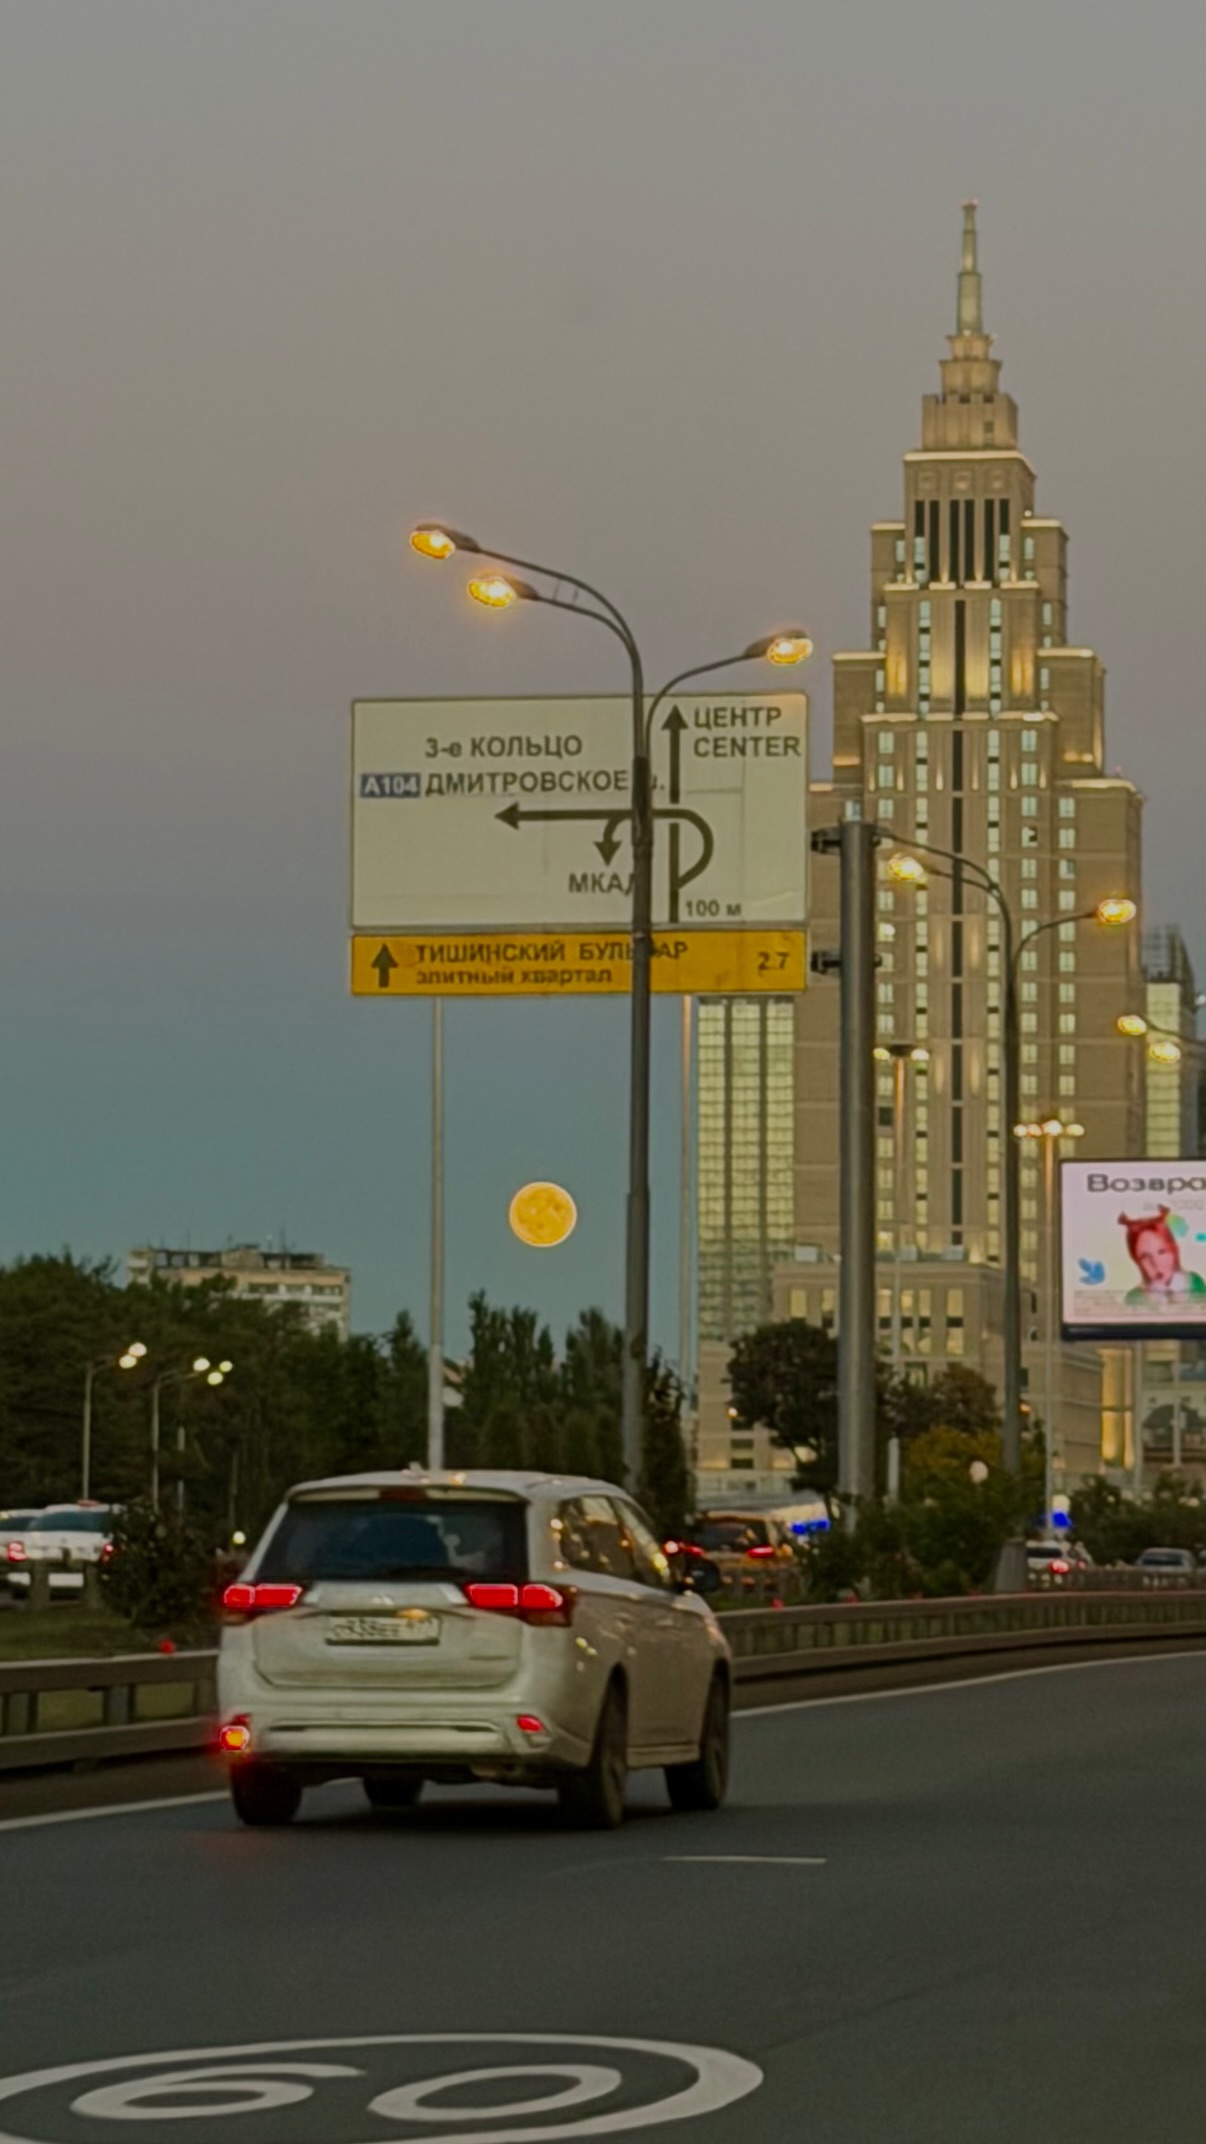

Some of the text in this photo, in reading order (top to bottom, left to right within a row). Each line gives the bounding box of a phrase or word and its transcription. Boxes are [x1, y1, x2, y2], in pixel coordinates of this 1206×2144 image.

[694, 705, 783, 730] ЦЕНТР
[424, 734, 584, 759] 3-е КОЛЬЦО
[693, 735, 802, 758] CENTER
[363, 774, 420, 797] А104
[425, 769, 629, 798] ДМИТРОВСКОЕ
[686, 899, 742, 917] 100 м
[415, 939, 566, 963] ТИШИНСКИЙ
[415, 965, 613, 985] элитный квартал
[70, 2062, 622, 2121] 60
